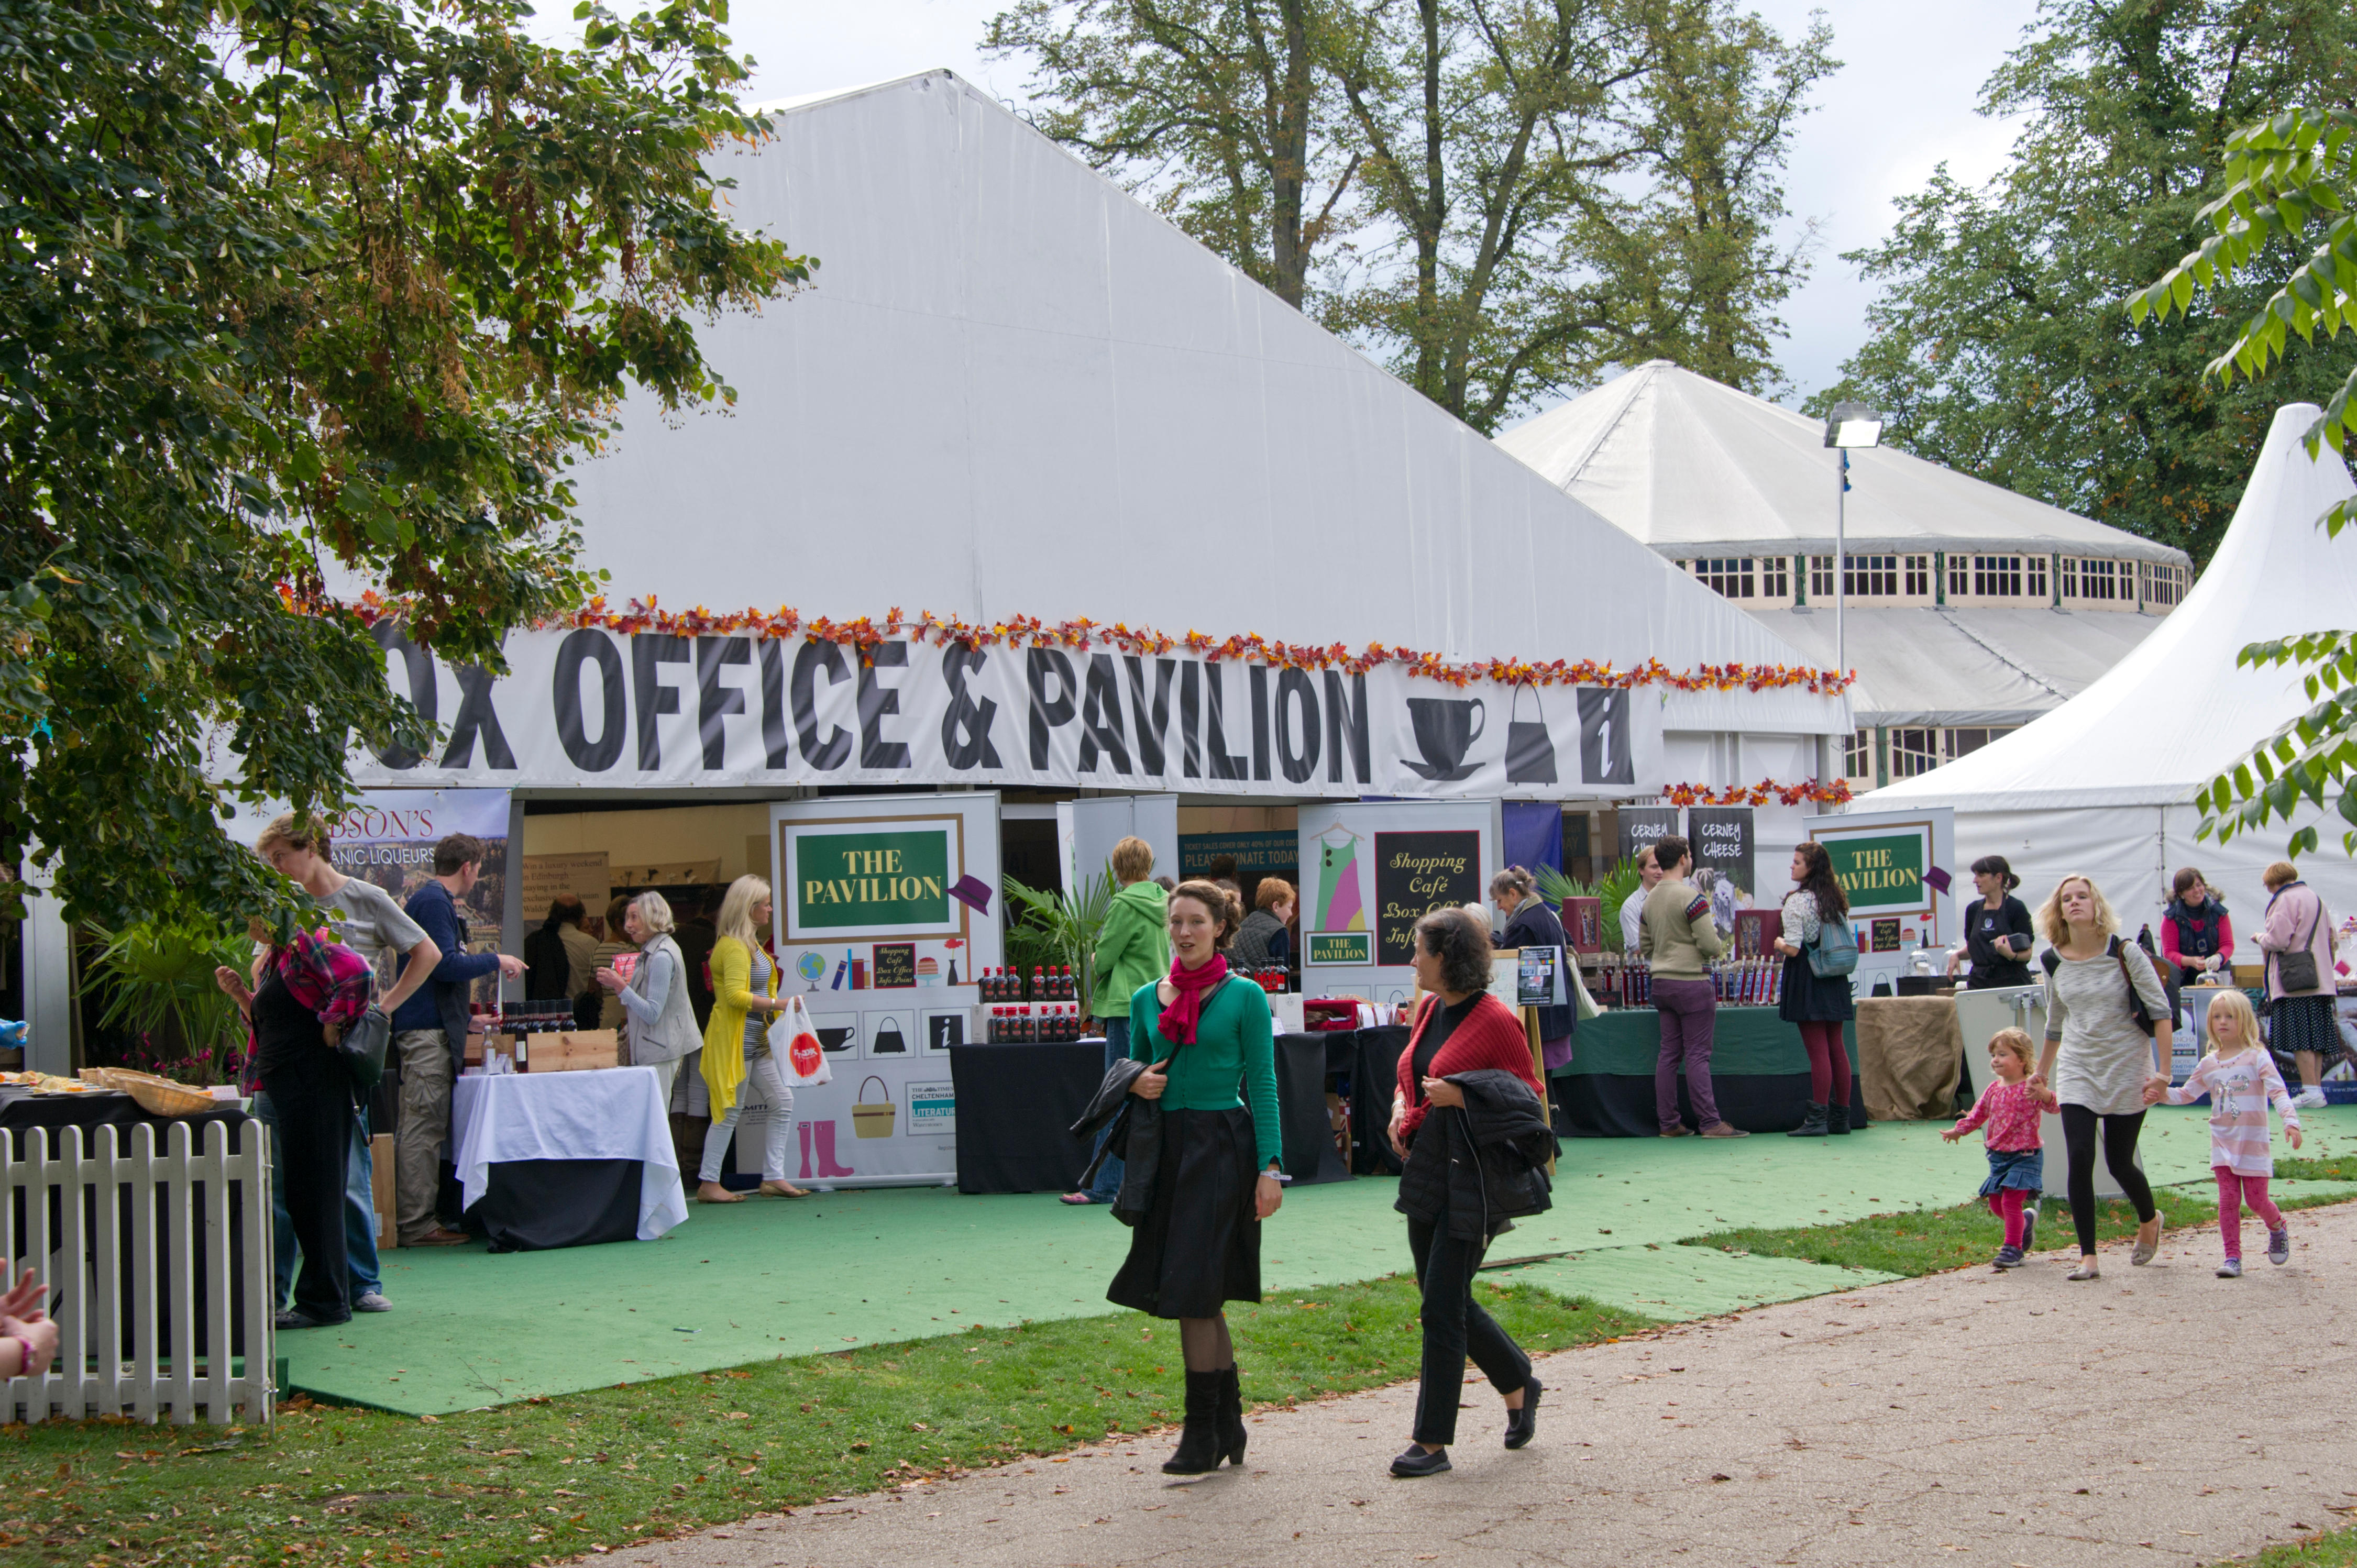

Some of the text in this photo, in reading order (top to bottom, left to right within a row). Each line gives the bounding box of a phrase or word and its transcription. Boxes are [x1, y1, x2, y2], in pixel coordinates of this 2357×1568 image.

[343, 619, 518, 770] OX
[553, 628, 912, 771] OFFICE
[942, 641, 1003, 770] &
[1027, 647, 1371, 784] PAVILION
[317, 810, 432, 838] BSON'S
[1631, 823, 1668, 838] CERNEY
[1702, 823, 1741, 842] CERNEY
[331, 847, 435, 865] ANIC LIQUEURS
[1703, 841, 1742, 858] CHEESE
[545, 862, 567, 870] luxury
[570, 859, 602, 868] weekend
[843, 849, 902, 875] THE
[1226, 851, 1265, 865] ONATE
[1390, 852, 1466, 874] Shopping
[1852, 849, 1892, 869] THE
[532, 871, 569, 881] Edinburgh
[805, 876, 942, 904] PAVILION
[1409, 876, 1448, 899] Café
[523, 893, 557, 902] exclusive
[1383, 902, 1420, 918] Box
[1328, 938, 1351, 948] THE
[879, 947, 910, 956] Shopping
[1314, 948, 1366, 960] PAVILION
[886, 956, 902, 966] Café
[893, 965, 913, 976] Office
[878, 976, 892, 986] Info
[913, 1107, 955, 1117] LITERATUR
